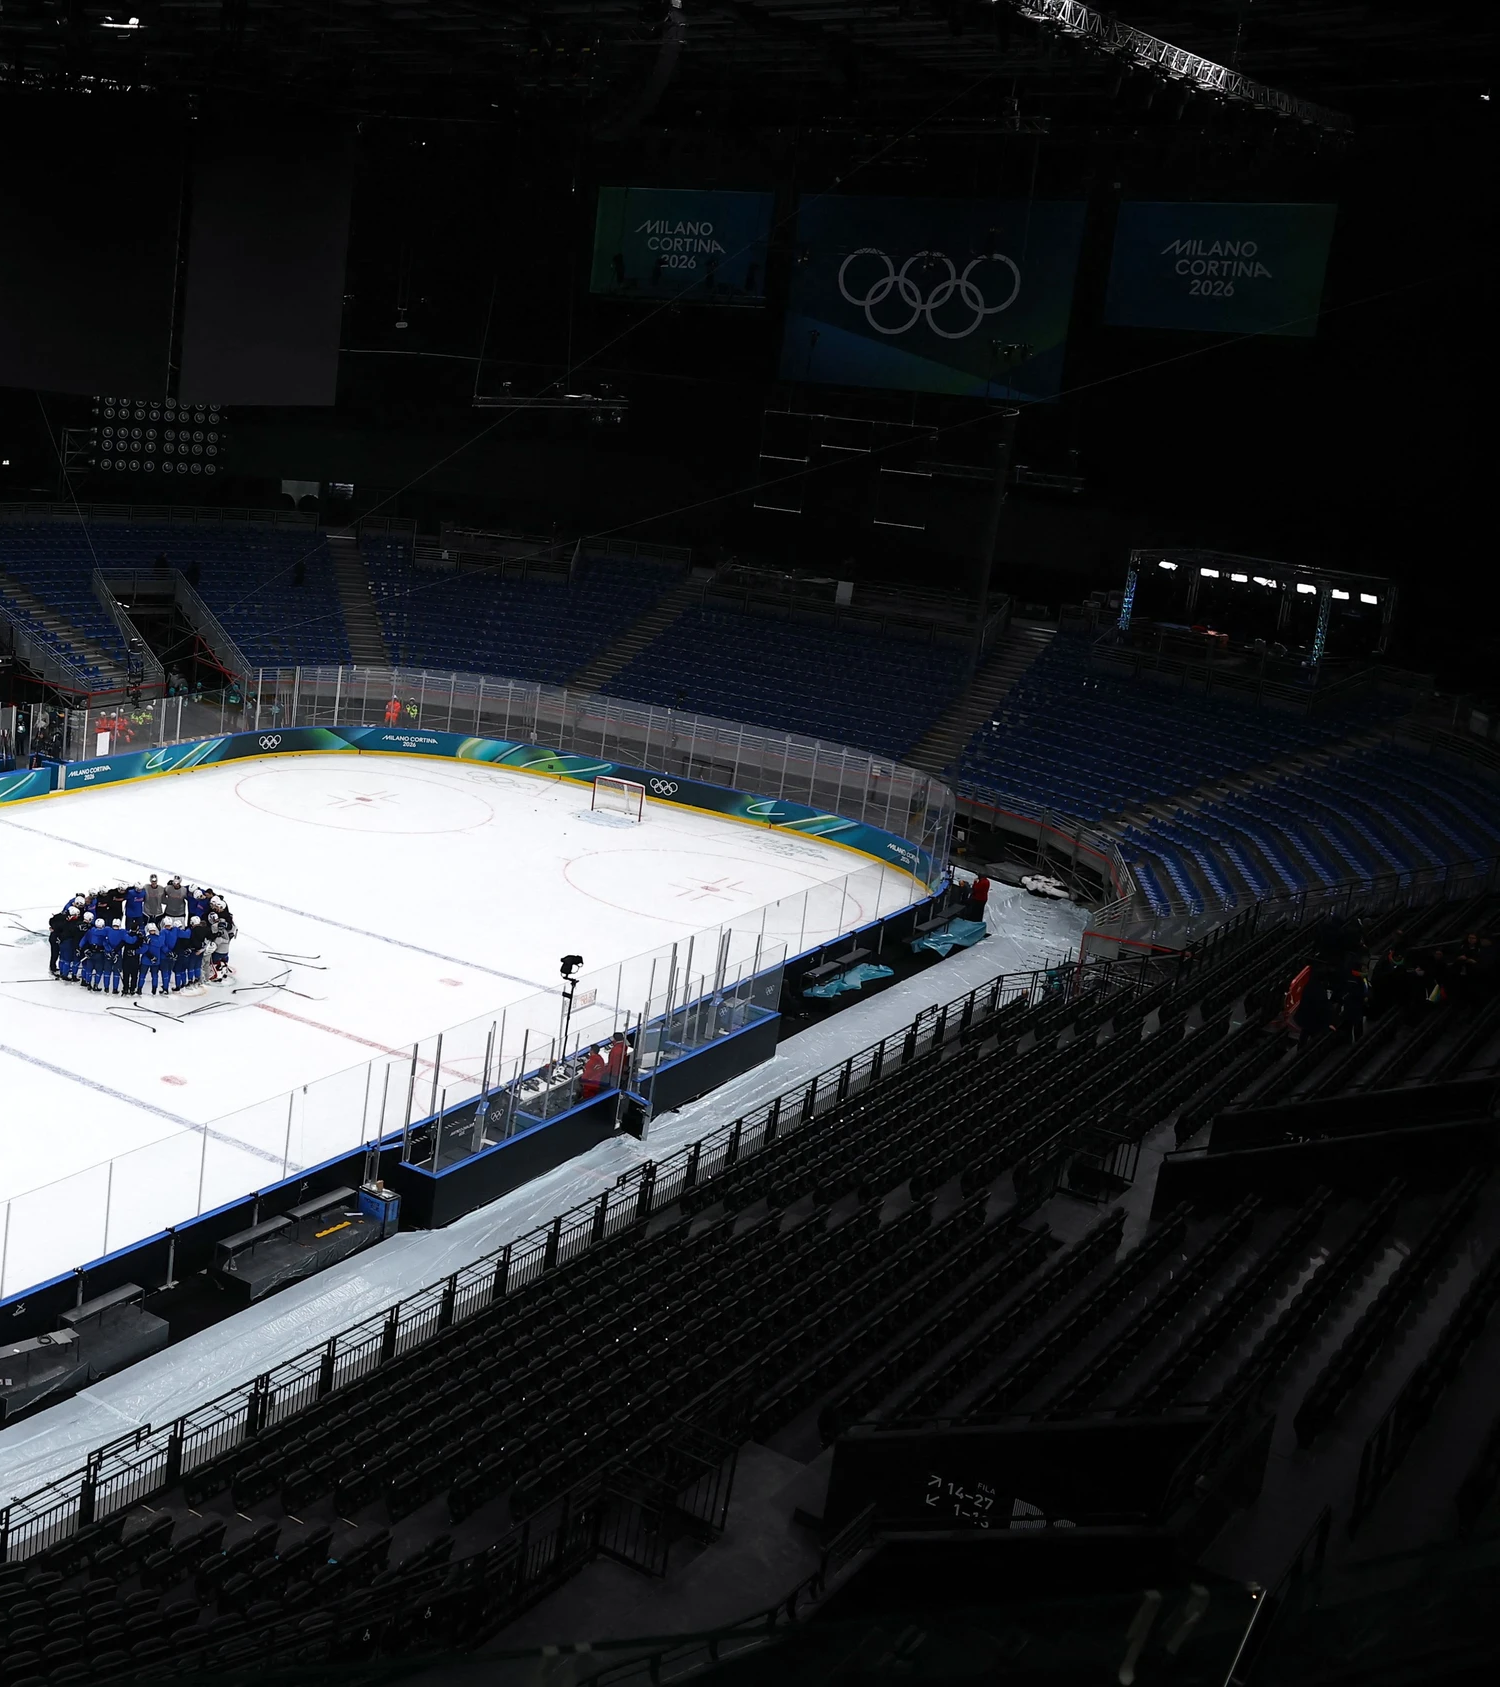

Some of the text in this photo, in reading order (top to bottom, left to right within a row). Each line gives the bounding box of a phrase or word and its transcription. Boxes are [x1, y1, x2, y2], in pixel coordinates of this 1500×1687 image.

[634, 220, 713, 236] MILANO
[647, 237, 726, 254] CORTINA
[1160, 239, 1257, 257] MILANO
[660, 254, 696, 269] 2026
[1175, 259, 1272, 278] CORTINA
[1189, 280, 1234, 297] 2026
[382, 734, 438, 744] MILANO CORTINA
[67, 765, 111, 778] MILANO CORTINA
[977, 1482, 996, 1496] FILA
